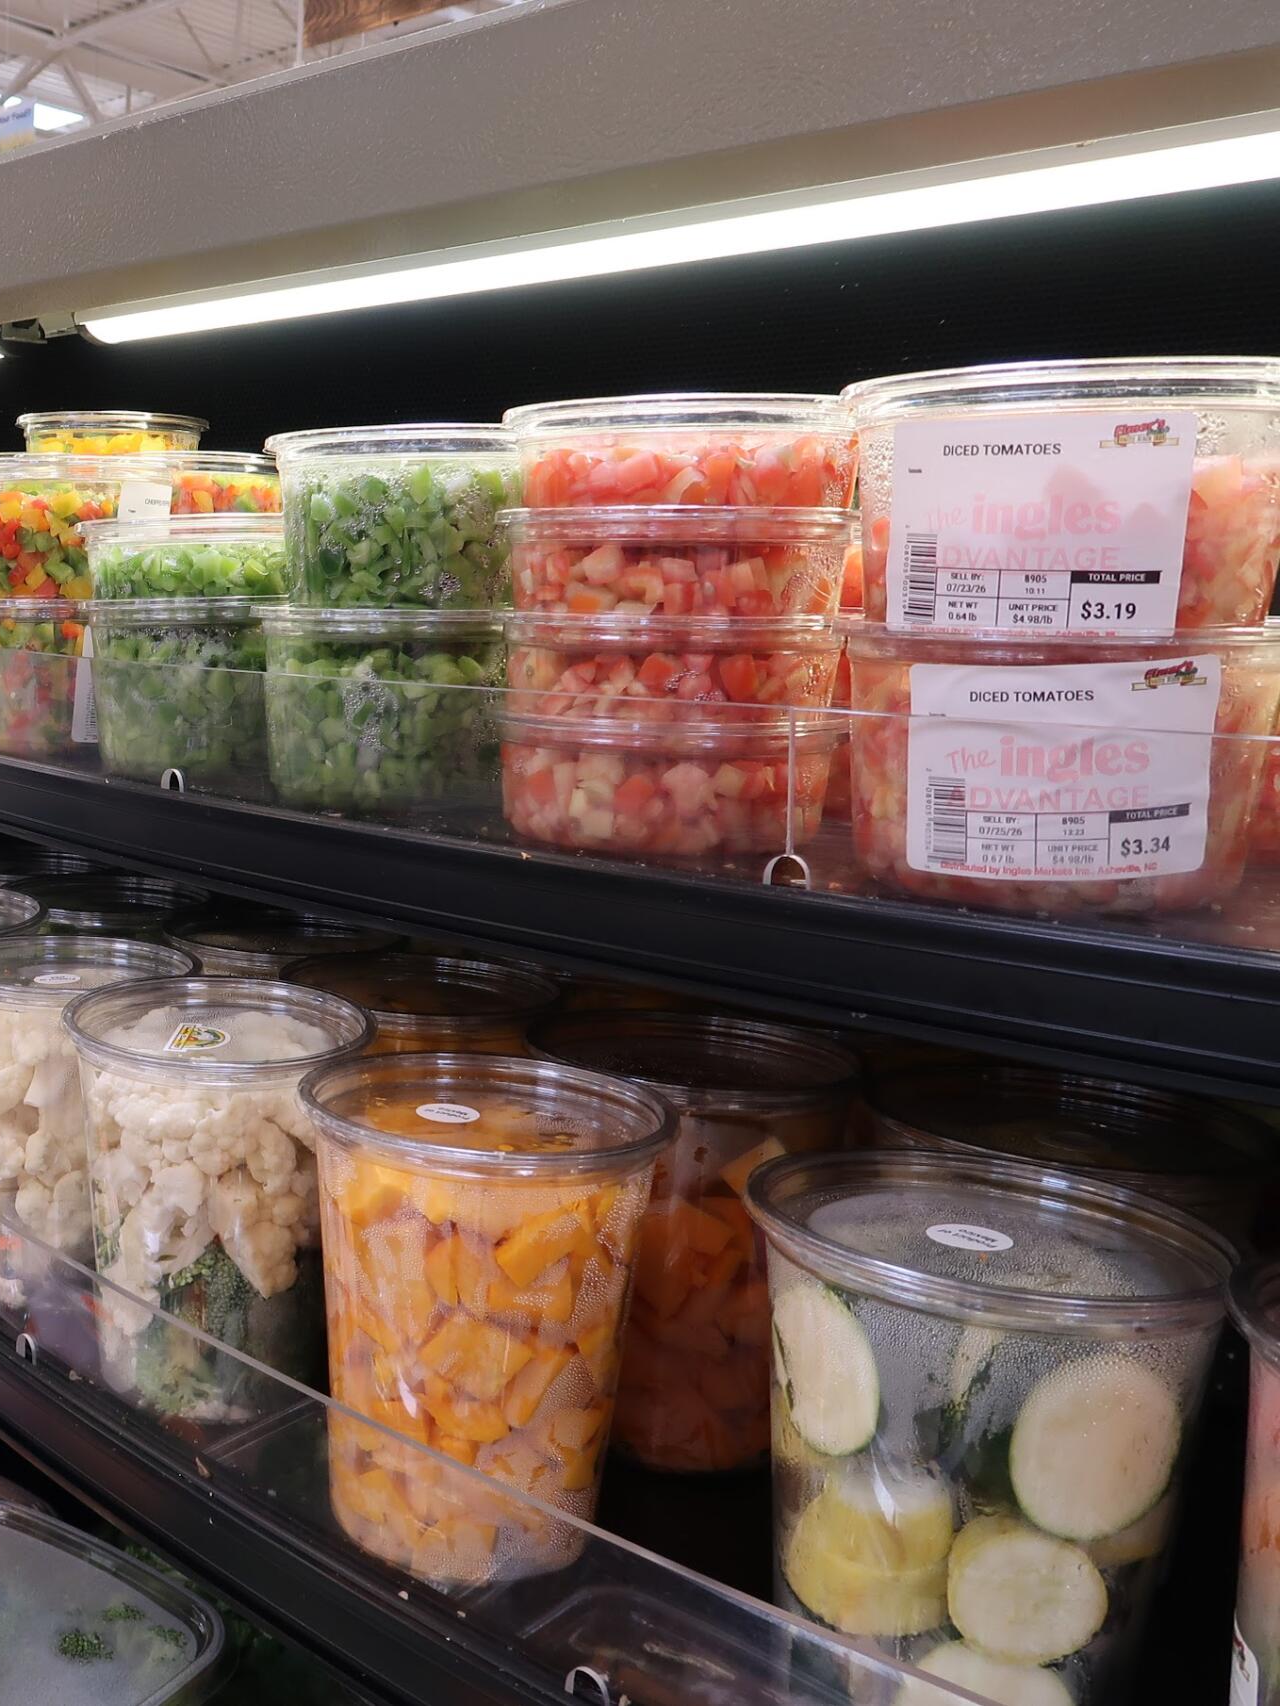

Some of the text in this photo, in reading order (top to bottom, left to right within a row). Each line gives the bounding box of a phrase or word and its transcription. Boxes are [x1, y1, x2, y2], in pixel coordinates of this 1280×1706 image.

[943, 443, 1061, 457] DICED TOMATOES
[971, 492, 1121, 541] ingles
[950, 572, 968, 580] SELL
[1024, 574, 1047, 584] 8905
[1088, 573, 1146, 582] TOTAL PRICE
[946, 583, 986, 594] 07/23/26
[948, 600, 978, 610] NET WT
[1008, 603, 1059, 613] UNIT PRICE
[1080, 600, 1137, 621] $3.19
[968, 612, 977, 622] lb
[1012, 613, 1053, 625] $4.98/lb
[970, 690, 1095, 703] DICED TOMATOES
[946, 735, 1151, 782] The ingles
[1125, 807, 1178, 820] TOTAL PRICE
[982, 815, 1003, 824] SELL
[1061, 816, 1086, 825] 8905
[978, 826, 1023, 836] 07/25/26
[981, 843, 999, 852] NET
[1047, 844, 1099, 853] UNIT PRICE
[1120, 836, 1171, 858] $3.34
[988, 865, 1001, 876] by
[1144, 862, 1158, 872] NC
